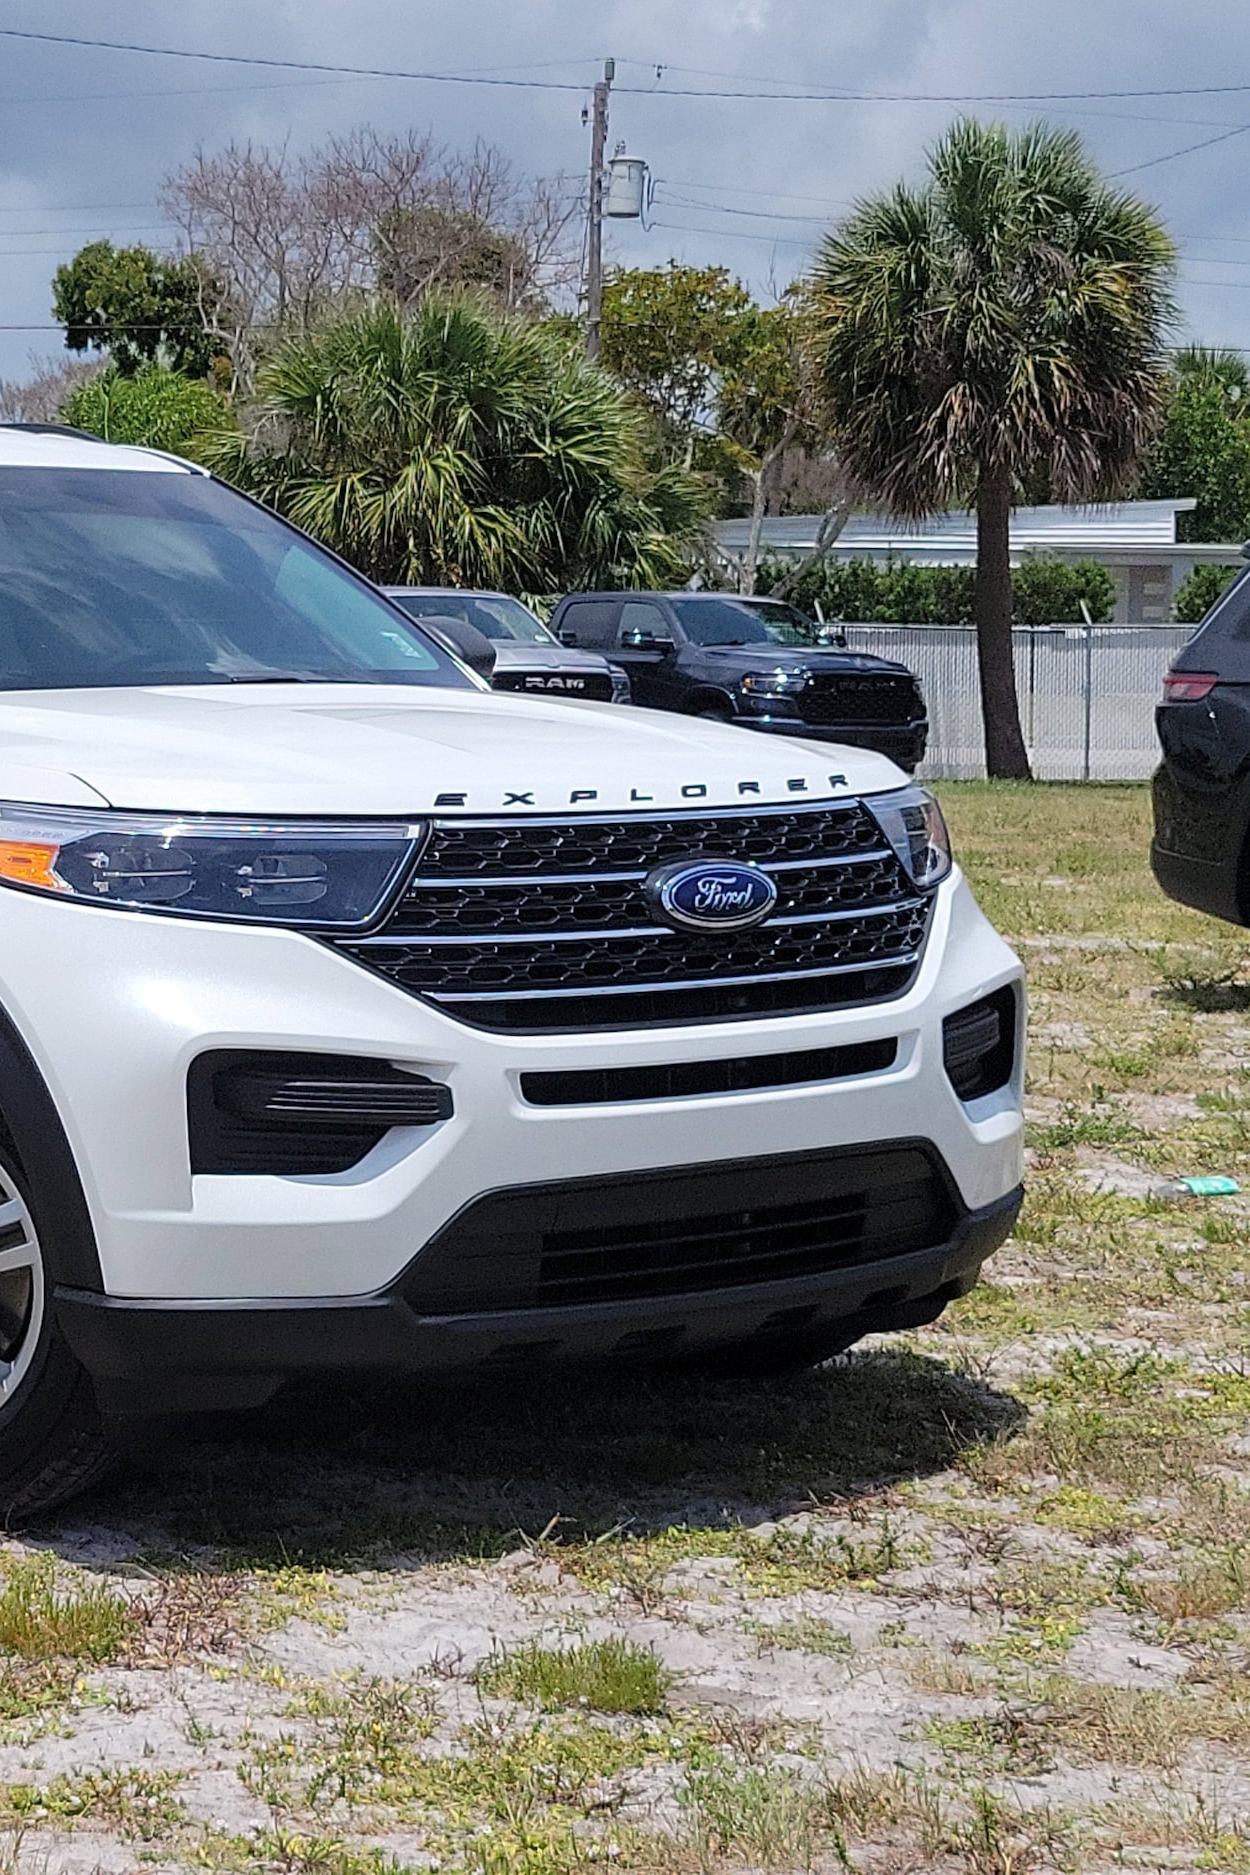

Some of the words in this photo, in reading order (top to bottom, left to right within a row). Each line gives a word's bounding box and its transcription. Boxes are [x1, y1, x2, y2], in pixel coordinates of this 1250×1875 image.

[525, 676, 585, 689] RAM
[433, 773, 850, 807] EXPLORER
[694, 876, 754, 912] Ford
